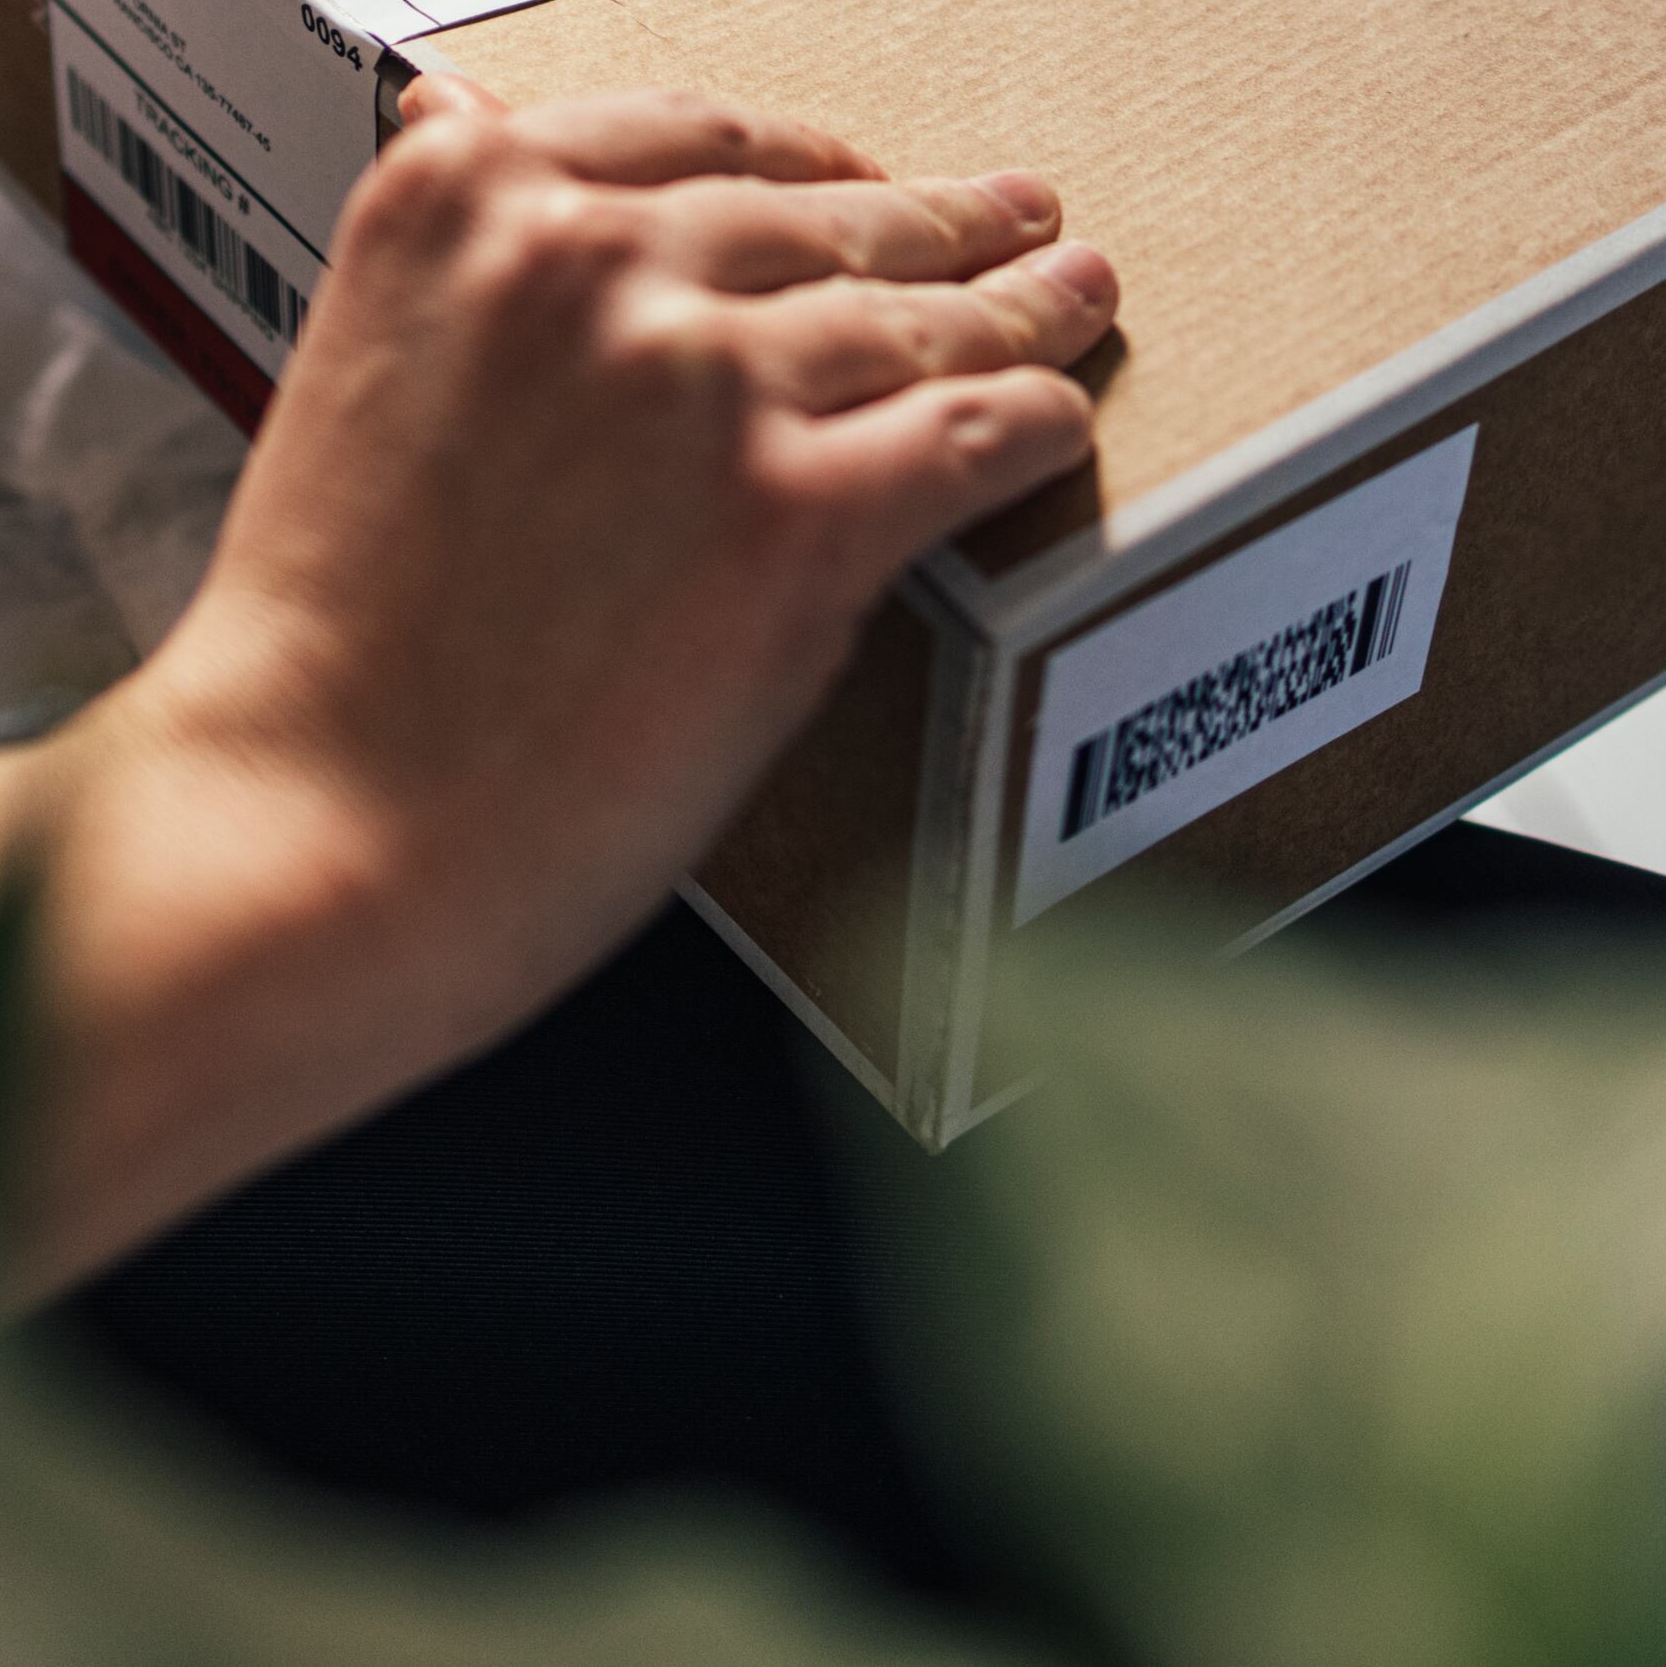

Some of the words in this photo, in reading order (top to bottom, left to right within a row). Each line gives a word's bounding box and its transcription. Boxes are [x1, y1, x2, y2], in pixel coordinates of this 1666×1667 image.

[175, 54, 193, 79] CA
[301, 3, 364, 72] 0094
[134, 89, 233, 201] TRACKING
